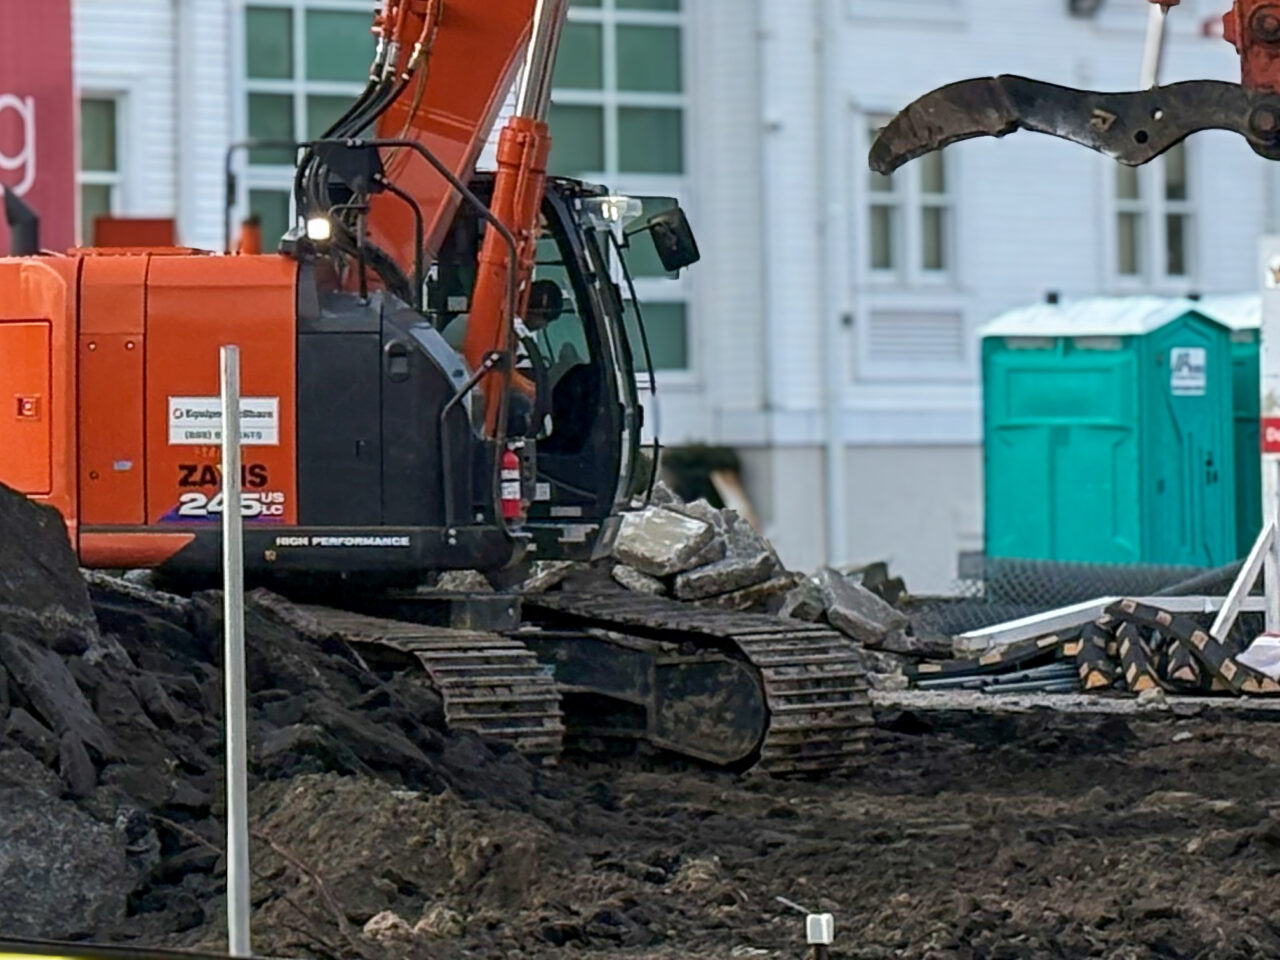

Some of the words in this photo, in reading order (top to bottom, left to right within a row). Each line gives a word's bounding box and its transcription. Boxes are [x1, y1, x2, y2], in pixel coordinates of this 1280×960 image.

[178, 464, 269, 488] ZAIS
[261, 492, 285, 503] US
[276, 536, 308, 546] HIGH
[311, 537, 410, 546] PERFORMANCE
